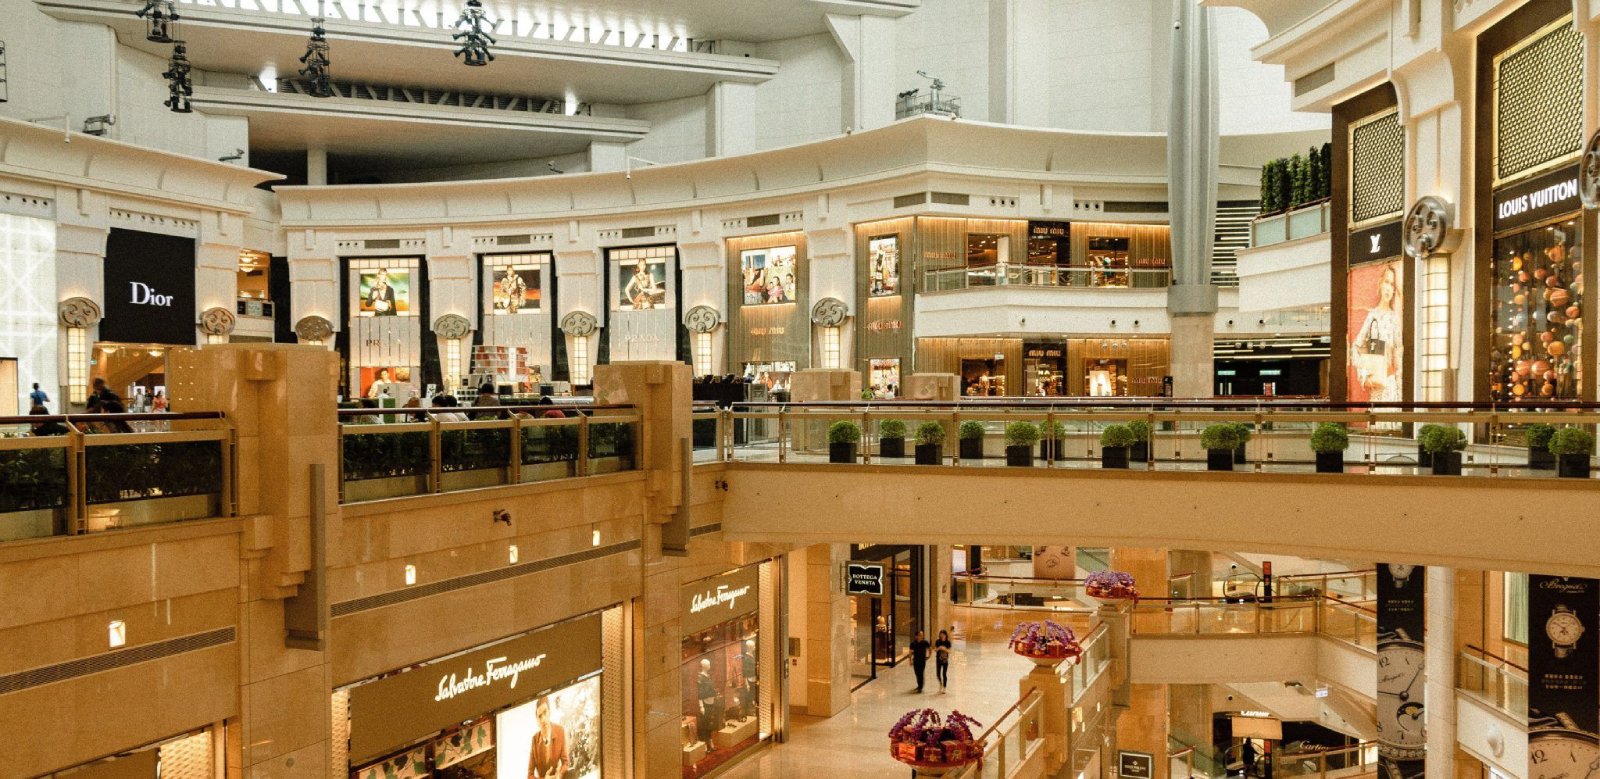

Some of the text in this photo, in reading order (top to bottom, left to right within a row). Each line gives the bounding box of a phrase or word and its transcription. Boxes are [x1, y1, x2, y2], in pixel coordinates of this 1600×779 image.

[1498, 178, 1578, 219] LOUIS VUITTON
[129, 281, 174, 307] Dior
[690, 585, 750, 613] Salvatore Ferragamo
[434, 656, 547, 702] Salvatore Ferragamo
